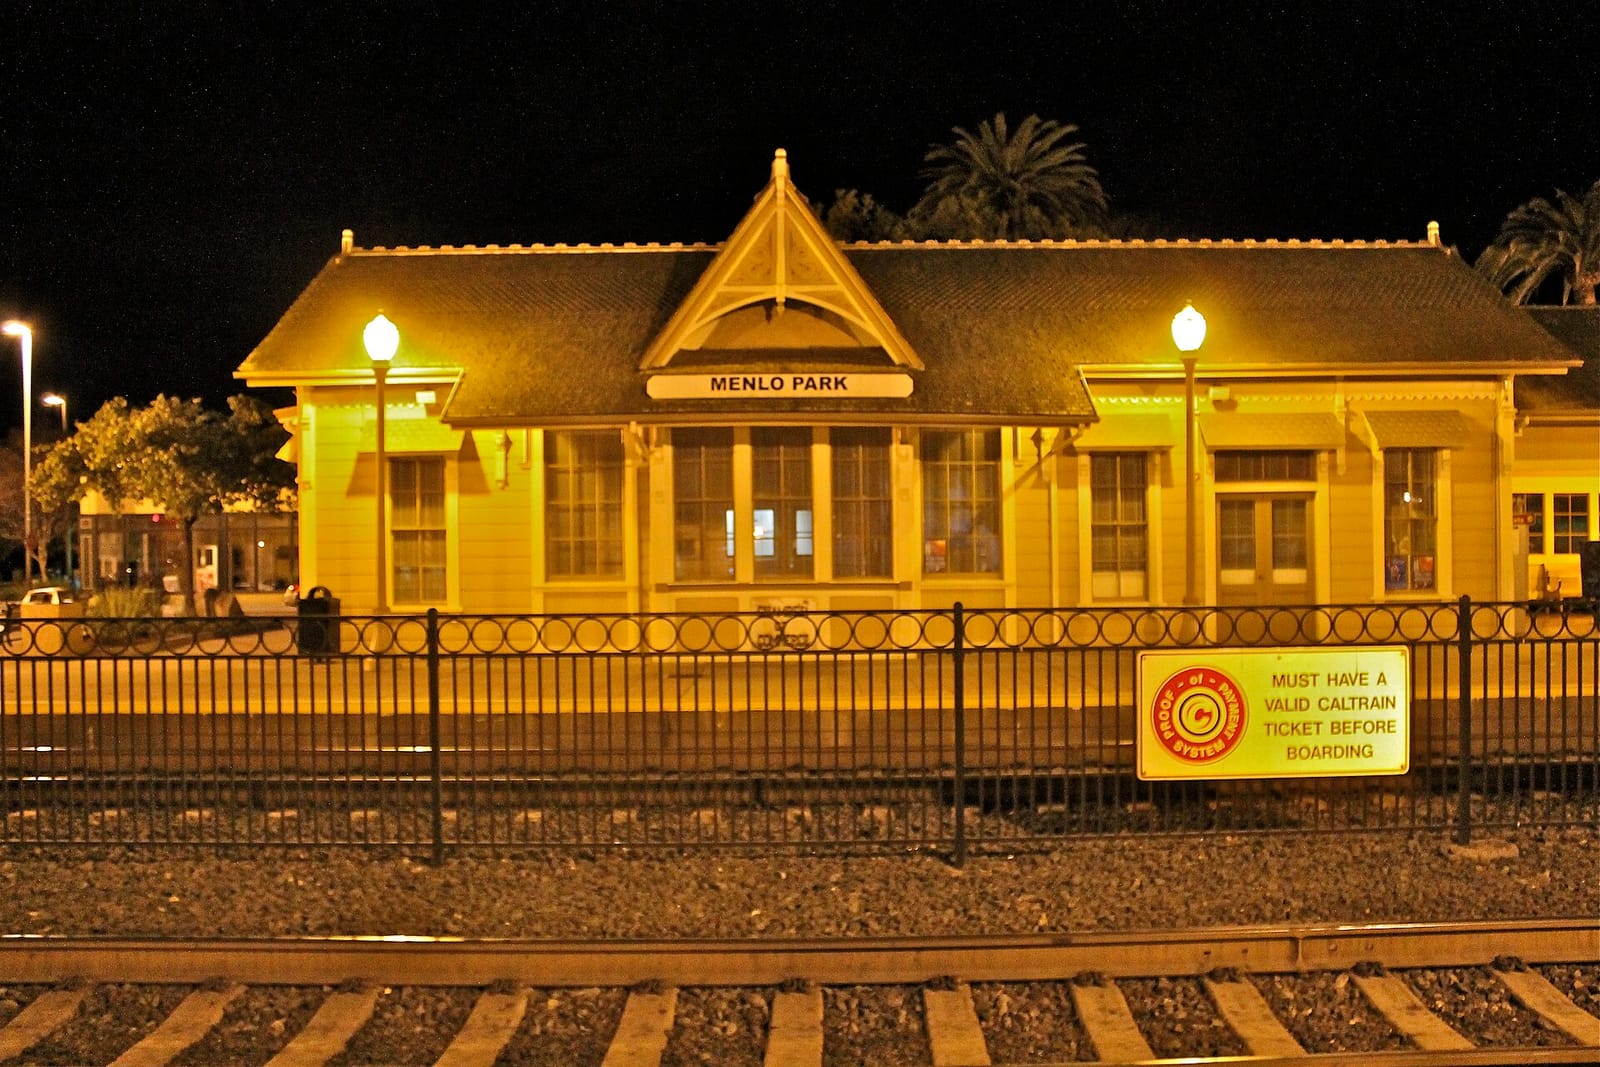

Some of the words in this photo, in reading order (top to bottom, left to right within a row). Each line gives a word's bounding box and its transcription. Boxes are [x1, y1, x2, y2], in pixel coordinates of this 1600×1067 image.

[711, 376, 785, 391] MENLO
[792, 376, 848, 390] PARK
[1272, 672, 1320, 688] MUST
[1327, 671, 1369, 687] HAVE
[1376, 672, 1387, 686] A
[1158, 689, 1175, 740] PROOF
[1217, 682, 1240, 740] PAYMENT
[1264, 697, 1310, 712] VALID
[1318, 695, 1396, 711] CALTRAIN
[1264, 721, 1323, 736] TICKET
[1330, 719, 1397, 735] BEFORE
[1173, 738, 1226, 758] SYSTEM
[1287, 743, 1374, 760] BOARDING
